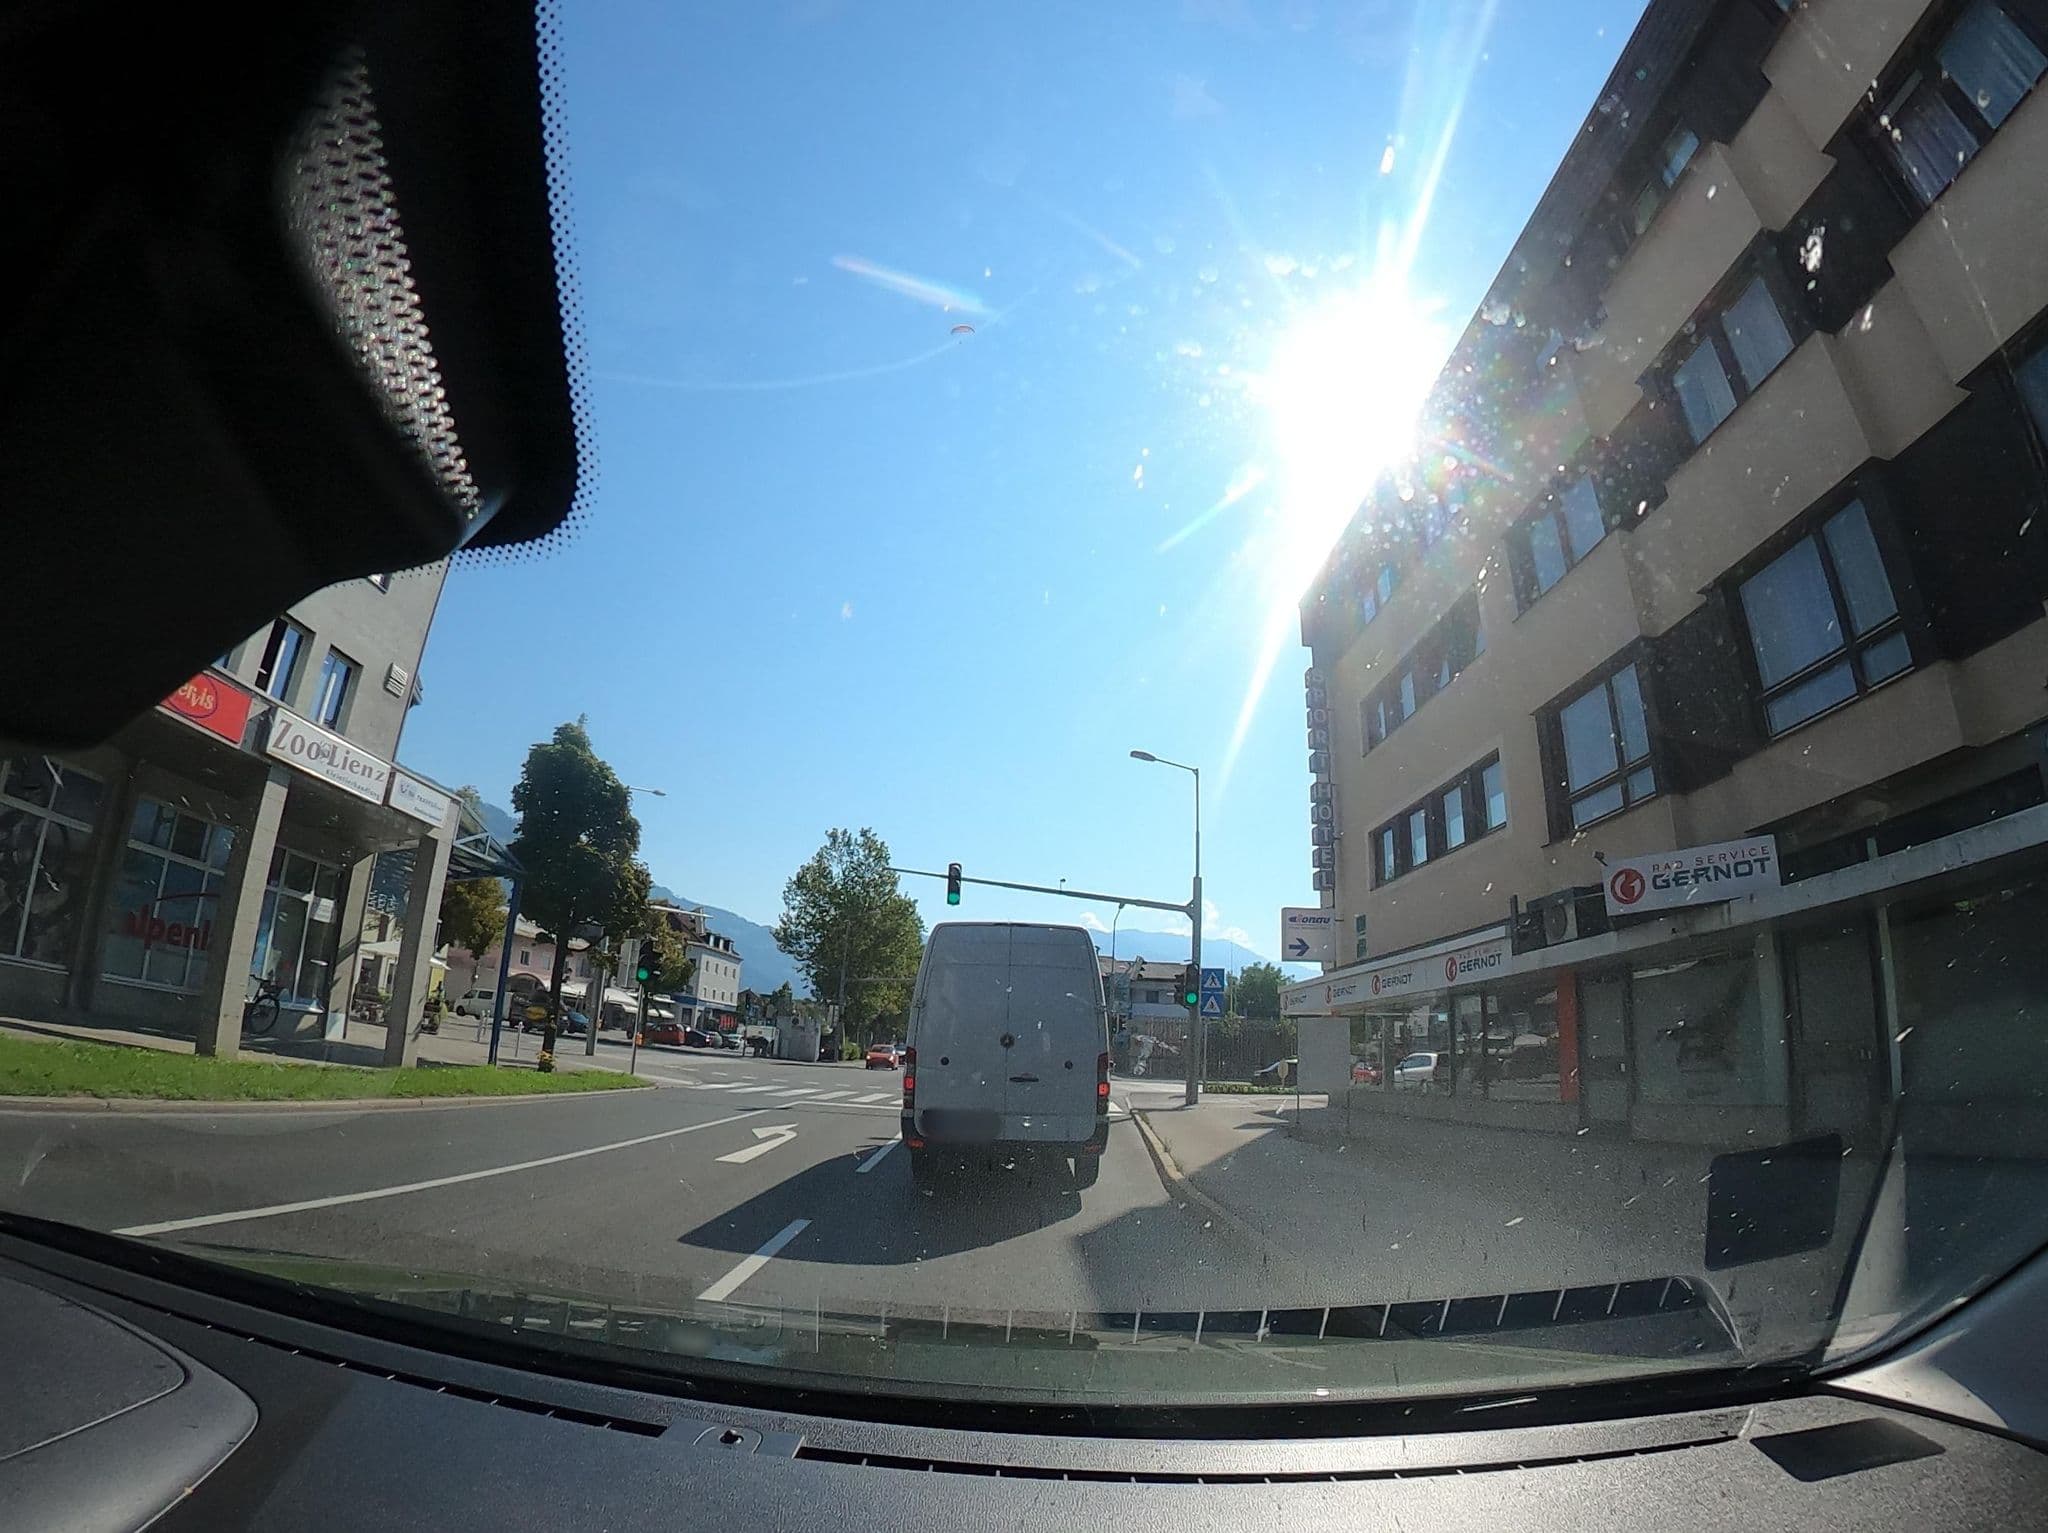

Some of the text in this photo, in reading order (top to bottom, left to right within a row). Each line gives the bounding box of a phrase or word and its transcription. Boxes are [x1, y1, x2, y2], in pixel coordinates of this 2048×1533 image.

[178, 684, 214, 710] ervis
[272, 719, 386, 783] Zoo Lienz
[1317, 783, 1333, 888] HOTEL
[1652, 845, 1770, 872] RAD SERVICE
[1652, 857, 1771, 890] GERNOT
[1459, 953, 1502, 973] GERNOT
[1382, 973, 1412, 988] GERNOT
